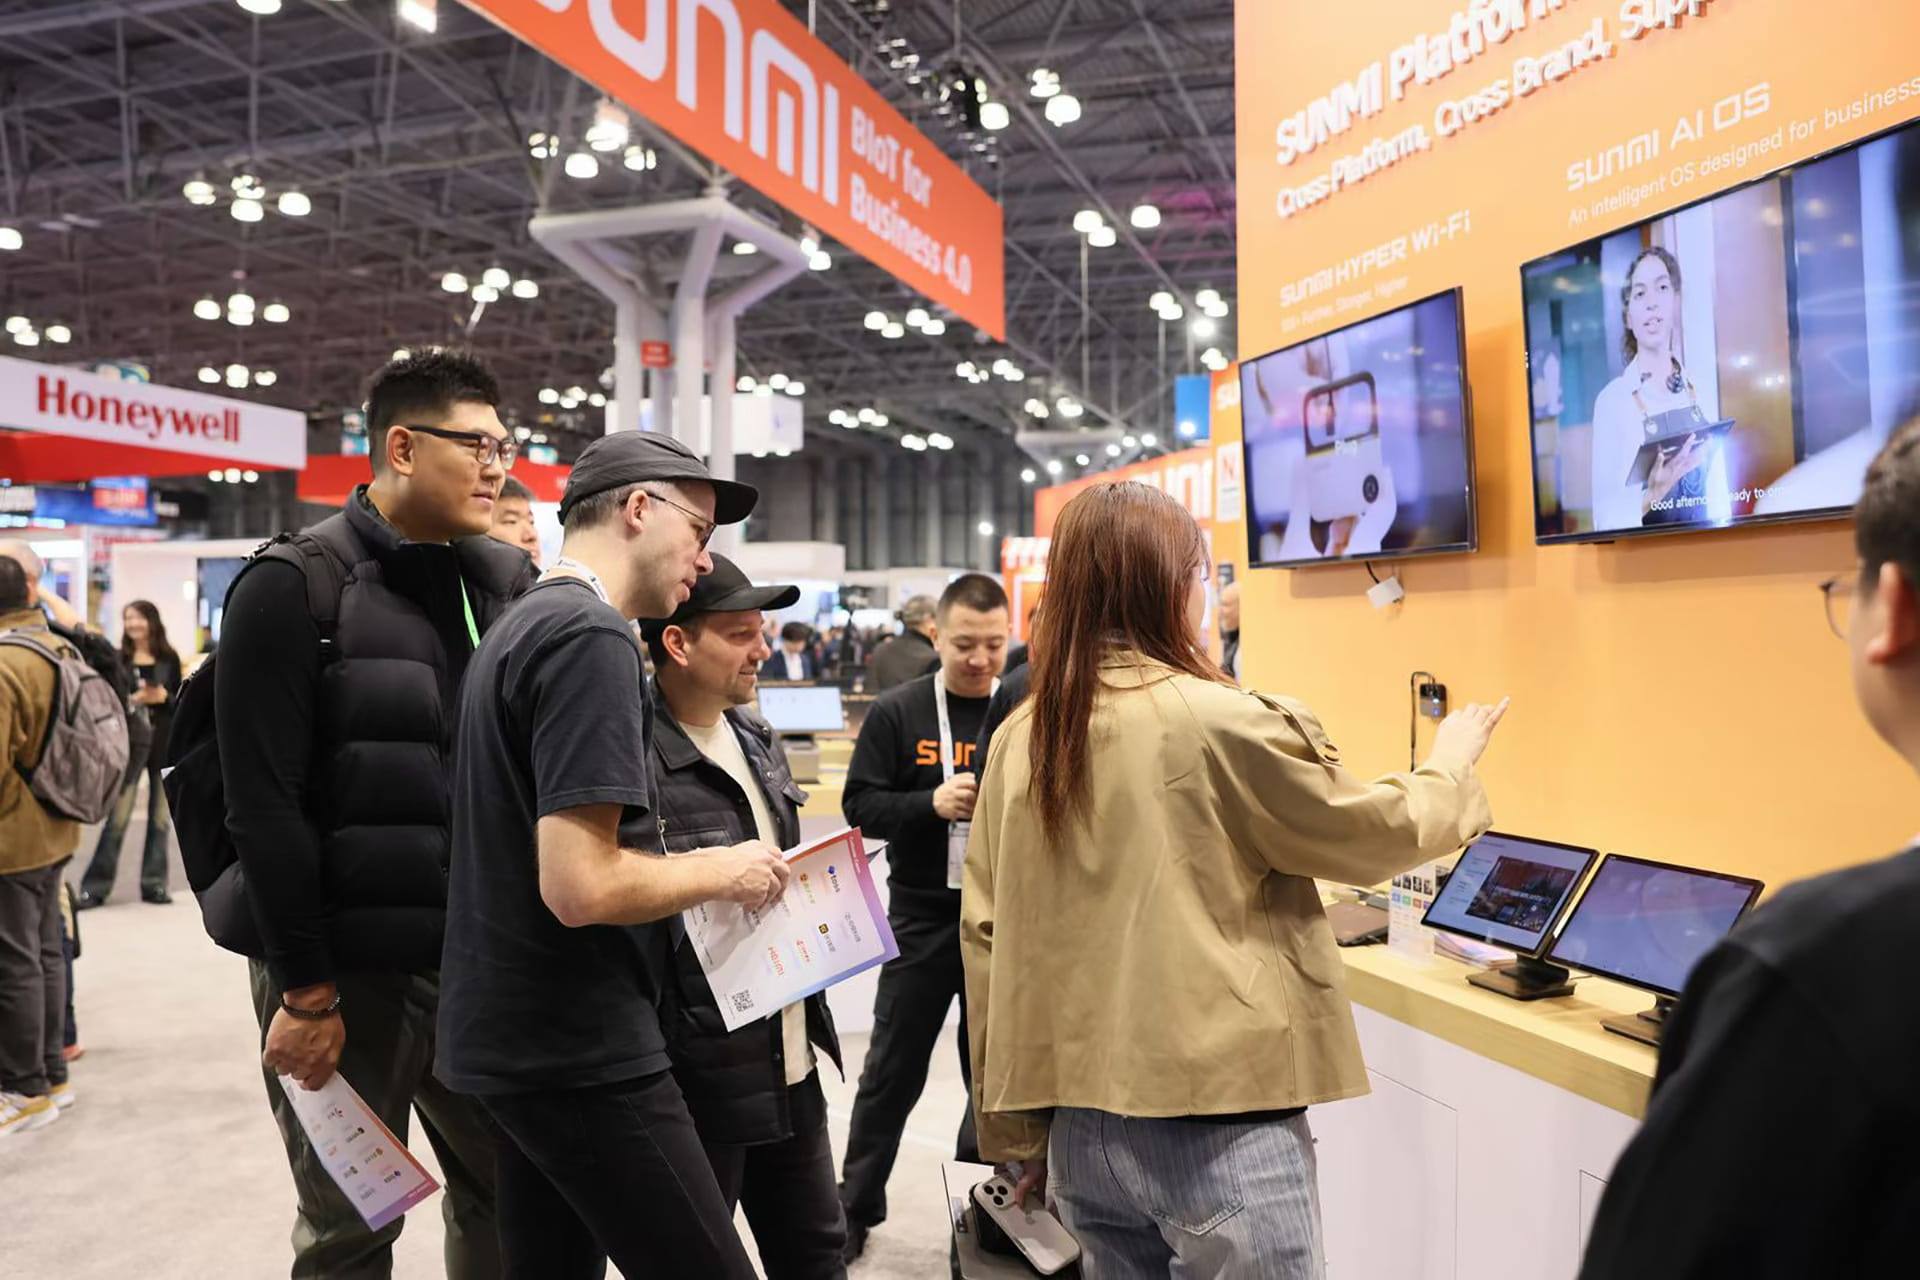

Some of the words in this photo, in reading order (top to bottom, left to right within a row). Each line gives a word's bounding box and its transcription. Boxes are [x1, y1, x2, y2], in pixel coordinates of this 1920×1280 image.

[852, 105, 900, 182] BIoT
[903, 147, 932, 209] for
[1275, 60, 1382, 166] SUNMI
[1276, 174, 1331, 219] Cross
[1435, 80, 1512, 137] Cross
[1513, 18, 1615, 97] Brand,
[1669, 108, 1704, 150] AI
[1713, 81, 1771, 131] OS
[1569, 208, 1588, 226] An
[1590, 174, 1668, 218] intelligent
[1670, 161, 1696, 188] OS
[1699, 127, 1783, 177] designed
[1788, 117, 1819, 145] for
[851, 172, 942, 275] Business
[943, 245, 972, 296] 4.0
[1334, 235, 1408, 286] HYPER
[1411, 209, 1471, 253] Wi-Fi
[37, 374, 241, 443] Honeywell
[1650, 497, 1674, 511] Good
[1754, 487, 1765, 499] to
